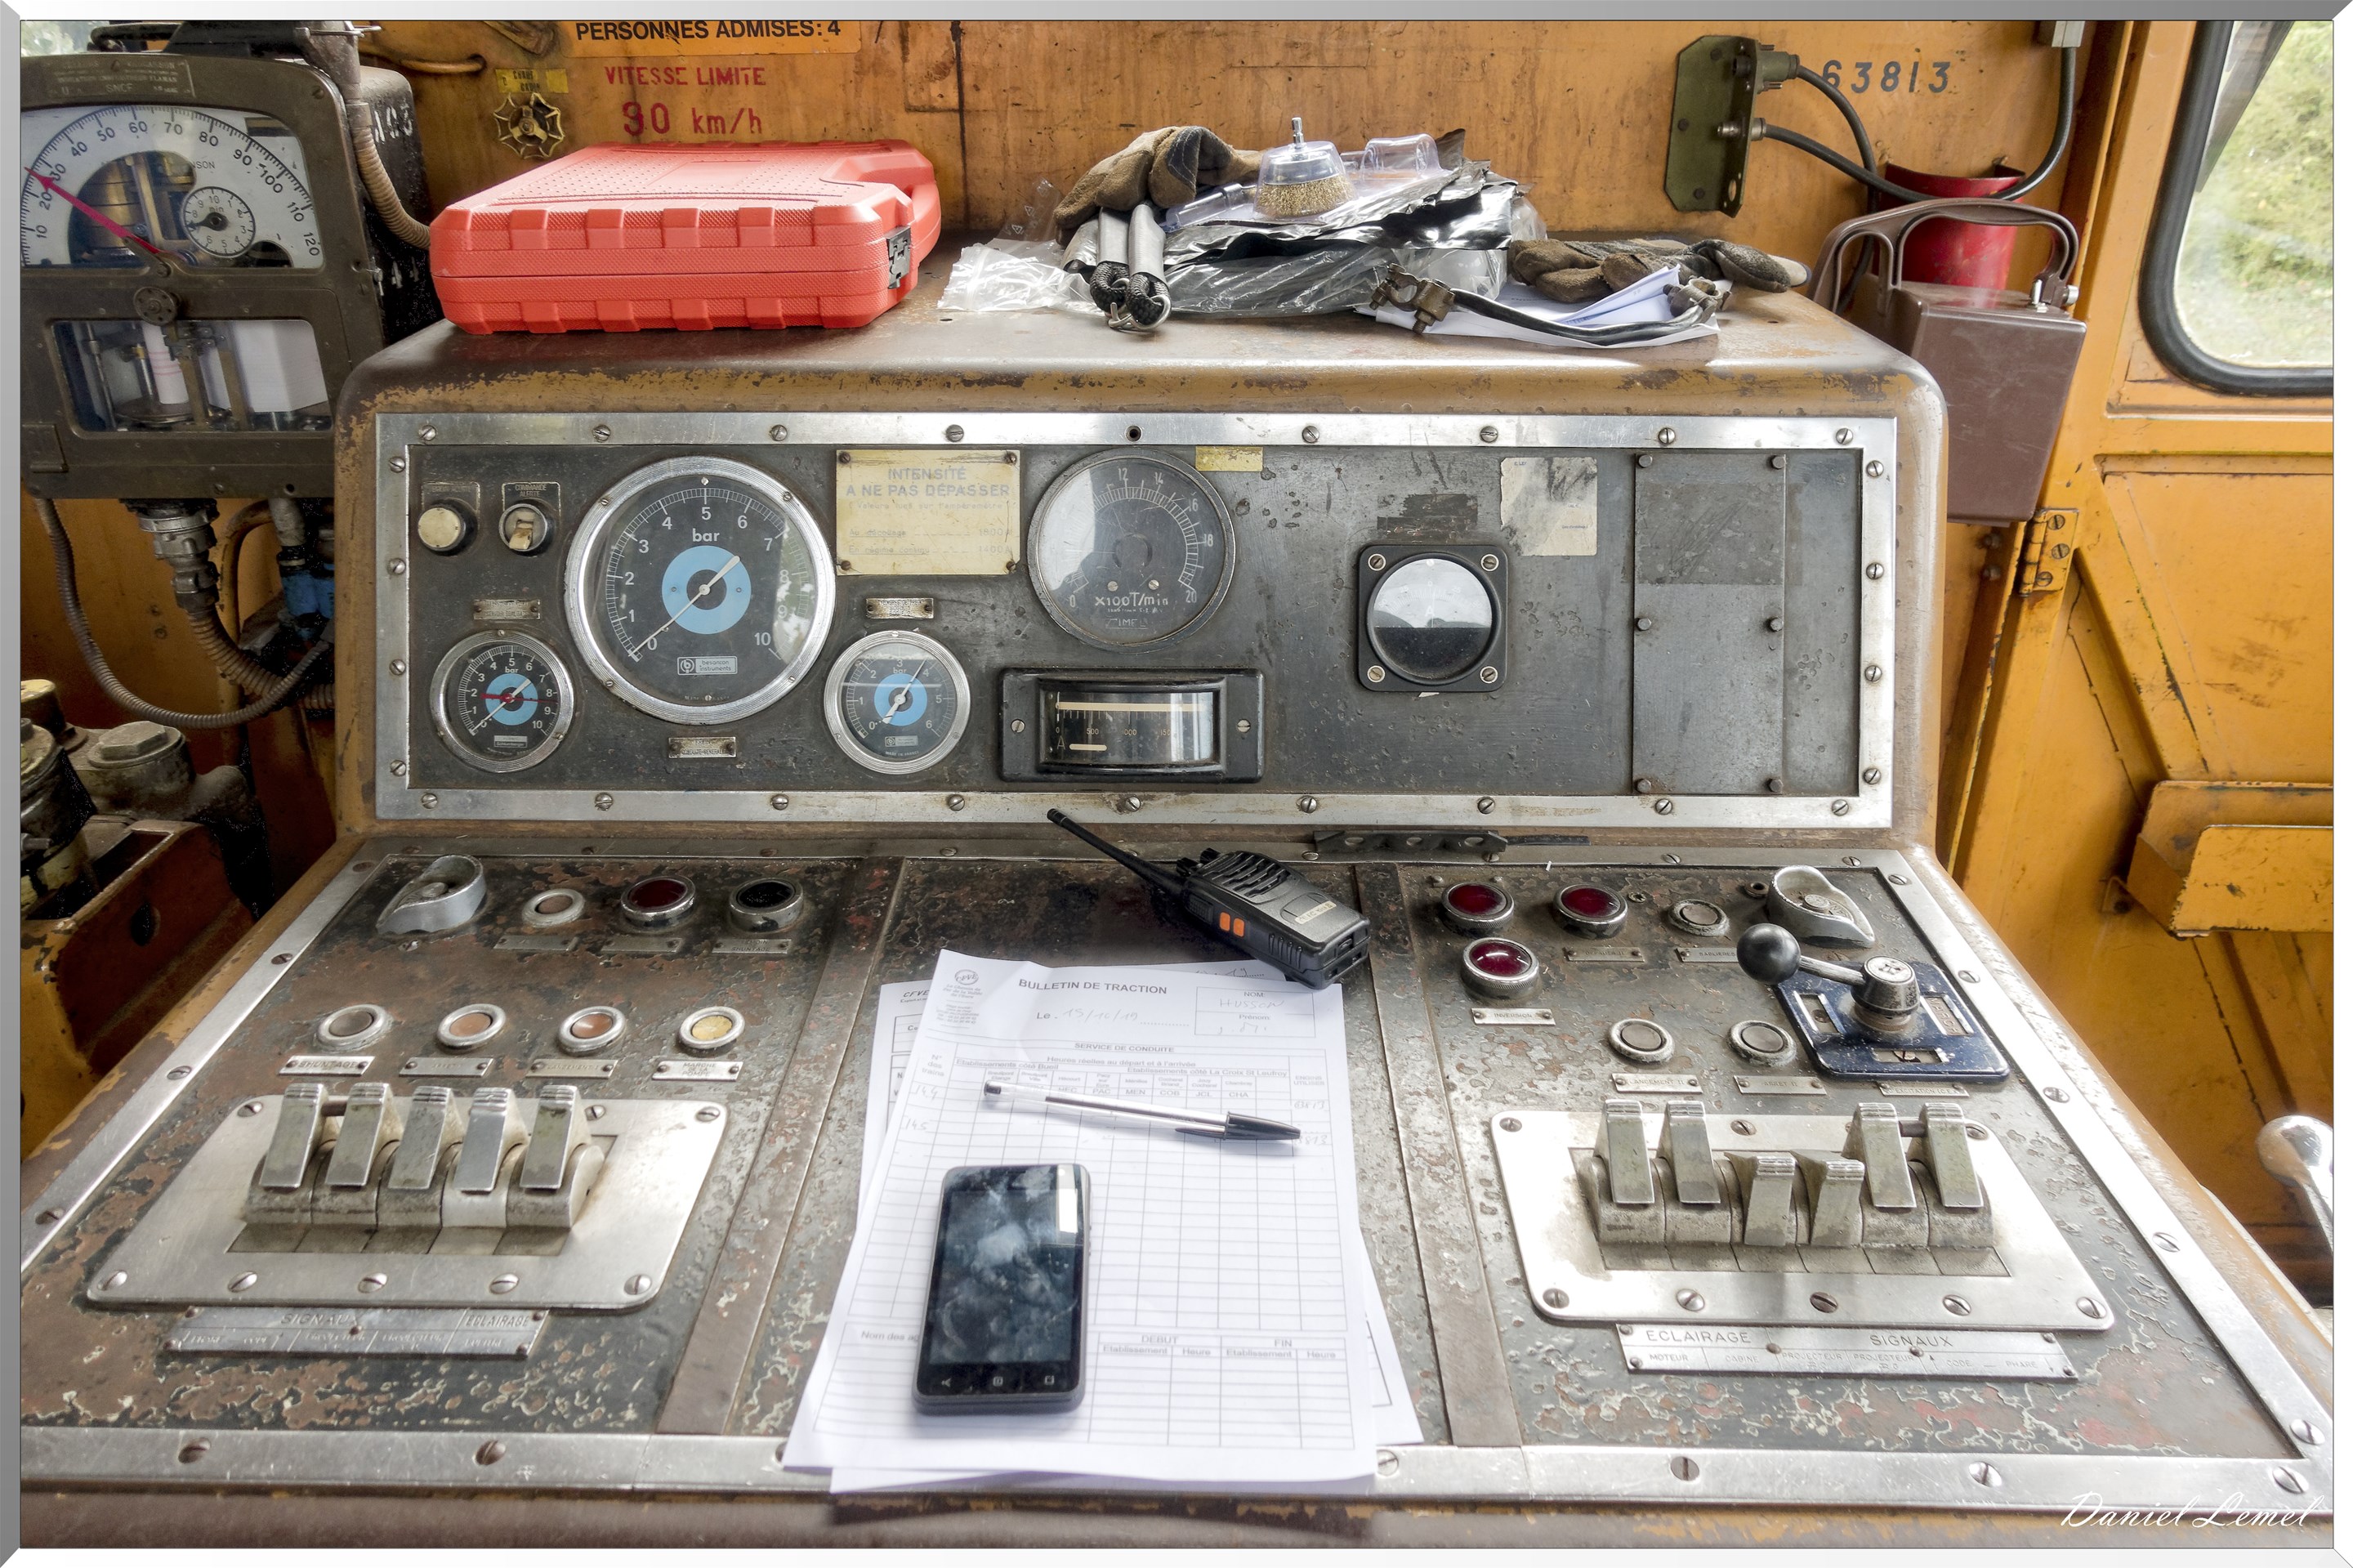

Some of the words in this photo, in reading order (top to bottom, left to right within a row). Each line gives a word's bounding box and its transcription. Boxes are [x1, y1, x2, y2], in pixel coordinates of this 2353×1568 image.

[576, 21, 709, 40] PERSONNES
[828, 20, 841, 35] 4
[605, 66, 688, 85] VITESSE
[697, 67, 766, 86] LIMITE
[1820, 59, 1951, 93] 63813
[105, 83, 133, 93] SNCF
[623, 101, 670, 136] 90
[692, 108, 761, 134] km/h
[128, 121, 148, 133] 60
[163, 122, 183, 135] 70
[97, 127, 115, 142] 50
[199, 132, 219, 146] 80
[71, 141, 87, 157] 40
[233, 149, 252, 166] 90
[50, 163, 66, 181] 30
[260, 170, 284, 194] 100
[39, 191, 52, 211] 20
[198, 200, 203, 208] 9
[209, 195, 220, 204] 10
[192, 210, 199, 218] 8
[287, 202, 305, 222] 110
[36, 225, 47, 239] 10
[241, 226, 247, 234] 3
[207, 235, 212, 243] 6
[222, 239, 227, 248] 5
[234, 235, 240, 243] 4
[303, 232, 320, 256] 120
[888, 466, 967, 480] INTENSITÉ
[1118, 468, 1128, 480] 12
[1155, 472, 1163, 485] 14
[846, 485, 856, 497] A
[862, 485, 882, 497] NE
[888, 485, 918, 497] PAS
[926, 483, 1010, 497] DÉPASSER
[702, 507, 711, 520] 5
[662, 517, 672, 529] 4
[738, 516, 748, 529] 6
[692, 528, 720, 542] bar
[1203, 534, 1213, 547] 18
[639, 540, 650, 553] 3
[764, 538, 772, 551] 7
[625, 572, 634, 585] 2
[779, 570, 789, 583] 8
[1069, 595, 1076, 607] 0
[1185, 591, 1197, 603] 20
[629, 610, 634, 622] 1
[778, 605, 788, 619] 9
[647, 637, 657, 650] 0
[754, 632, 770, 646] 10
[490, 662, 497, 670] 4
[526, 663, 532, 671] 6
[896, 659, 903, 667] 3
[870, 670, 877, 679] 2
[922, 668, 929, 677] 4
[471, 689, 477, 697] 2
[547, 689, 552, 697] 8
[935, 695, 942, 704] 5
[545, 707, 551, 715] 9
[869, 721, 876, 730] 0
[926, 720, 932, 729] 6
[1056, 737, 1065, 750] A
[1019, 979, 1080, 990] BULLETIN
[1083, 981, 1101, 989] DE
[1105, 983, 1168, 994] TRACTION
[903, 989, 930, 998] CFVE
[1036, 1012, 1051, 1020] Le
[1074, 1042, 1112, 1051] SERVICE
[1128, 1045, 1174, 1053] CONDUITE
[956, 1058, 1017, 1068] Etablissements
[1019, 1061, 1036, 1070] côté
[1047, 1056, 1076, 1064] Heures
[922, 1068, 944, 1077] trains
[862, 1330, 885, 1340] Nom
[887, 1332, 905, 1340] des
[1141, 1335, 1178, 1344] DEBUT
[1646, 1330, 1752, 1343] ECLAIRAGE
[1870, 1335, 1953, 1347] SIGNAUX
[1104, 1344, 1168, 1355] Etablissement
[1183, 1347, 1211, 1356] Heure
[1227, 1349, 1292, 1358] Etablissement
[1307, 1351, 1336, 1359] Heure
[1650, 1353, 1688, 1362] MOTEUR
[1726, 1355, 1760, 1363] CABINE
[1783, 1352, 1842, 1360] PROJECTEUR
[1854, 1353, 1913, 1361] PROJECTEUR
[2006, 1360, 2038, 1369] PHARE
